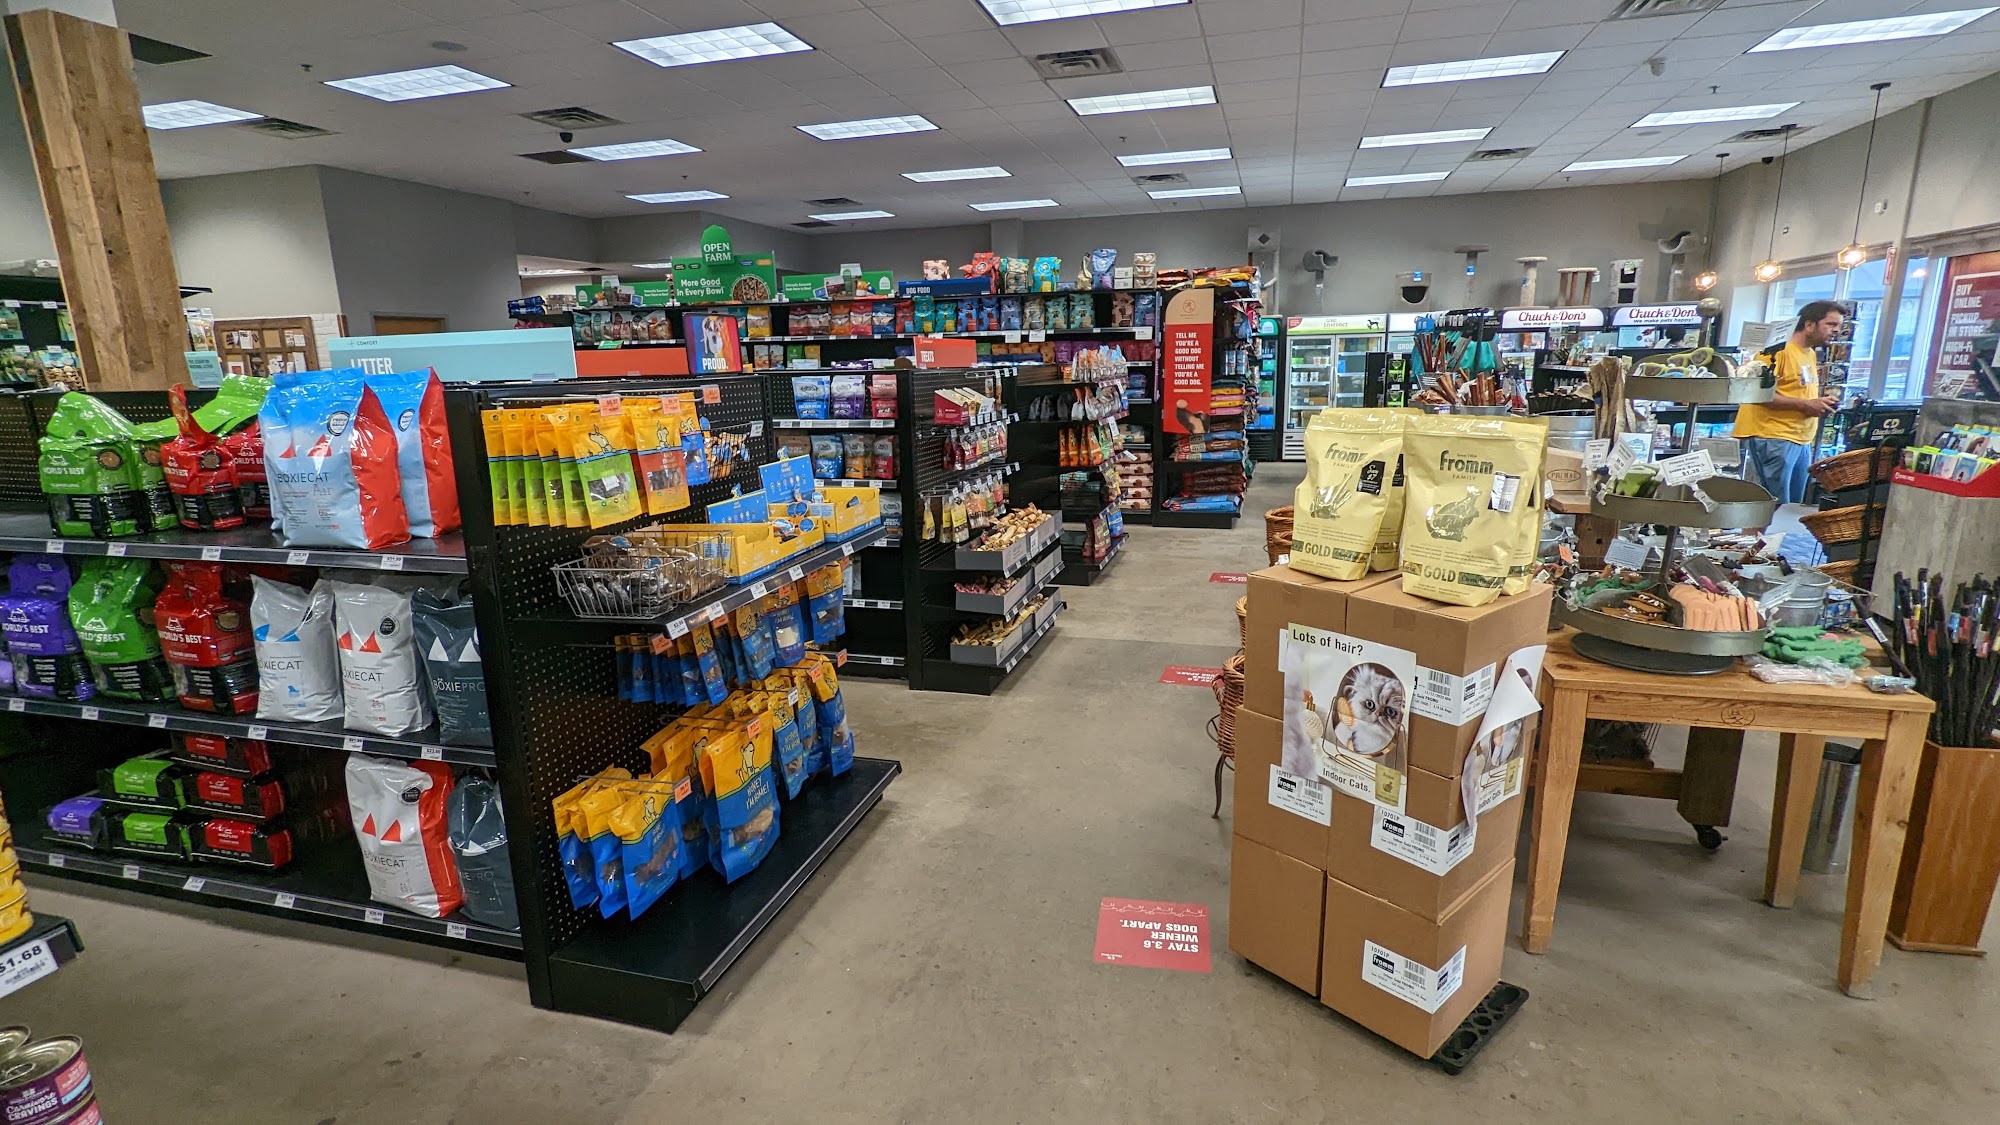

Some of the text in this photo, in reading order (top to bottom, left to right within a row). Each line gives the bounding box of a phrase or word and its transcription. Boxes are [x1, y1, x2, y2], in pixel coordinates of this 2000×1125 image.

[703, 242, 730, 253] OPEN
[705, 252, 731, 262] FARM
[681, 278, 721, 287] More Good
[685, 288, 704, 297] Every
[706, 286, 724, 295] Bowl
[1955, 284, 1973, 295] BUY
[1951, 313, 1979, 324] PICKUP
[1948, 327, 1958, 337] IN
[921, 351, 934, 363] TREATS
[1943, 354, 1970, 365] IN CAR.
[702, 358, 728, 370] PROUD.
[1440, 450, 1493, 475] fromm
[1551, 472, 1577, 480] PRIMAL
[1304, 543, 1331, 557] GOLD
[1424, 566, 1456, 582] GOLD
[30, 624, 49, 634] BEST
[102, 633, 125, 642] BEST
[185, 634, 202, 644] BEST
[1293, 628, 1363, 656] Lots of hair?
[257, 658, 301, 671] ÖXIECAT
[747, 776, 762, 796] HONEY
[1323, 768, 1371, 793] Indoor Cats.
[754, 782, 770, 805] HOME!
[1381, 810, 1400, 820] 10701P
[1383, 818, 1404, 834] fromm
[1120, 919, 1198, 932] DOGS APART.
[1151, 931, 1198, 942] WIENER
[1143, 940, 1199, 953] STAY 3.6
[1371, 946, 1389, 958] 10701P
[1373, 954, 1393, 970] fromm
[8, 1097, 58, 1120] CRAVINGS
